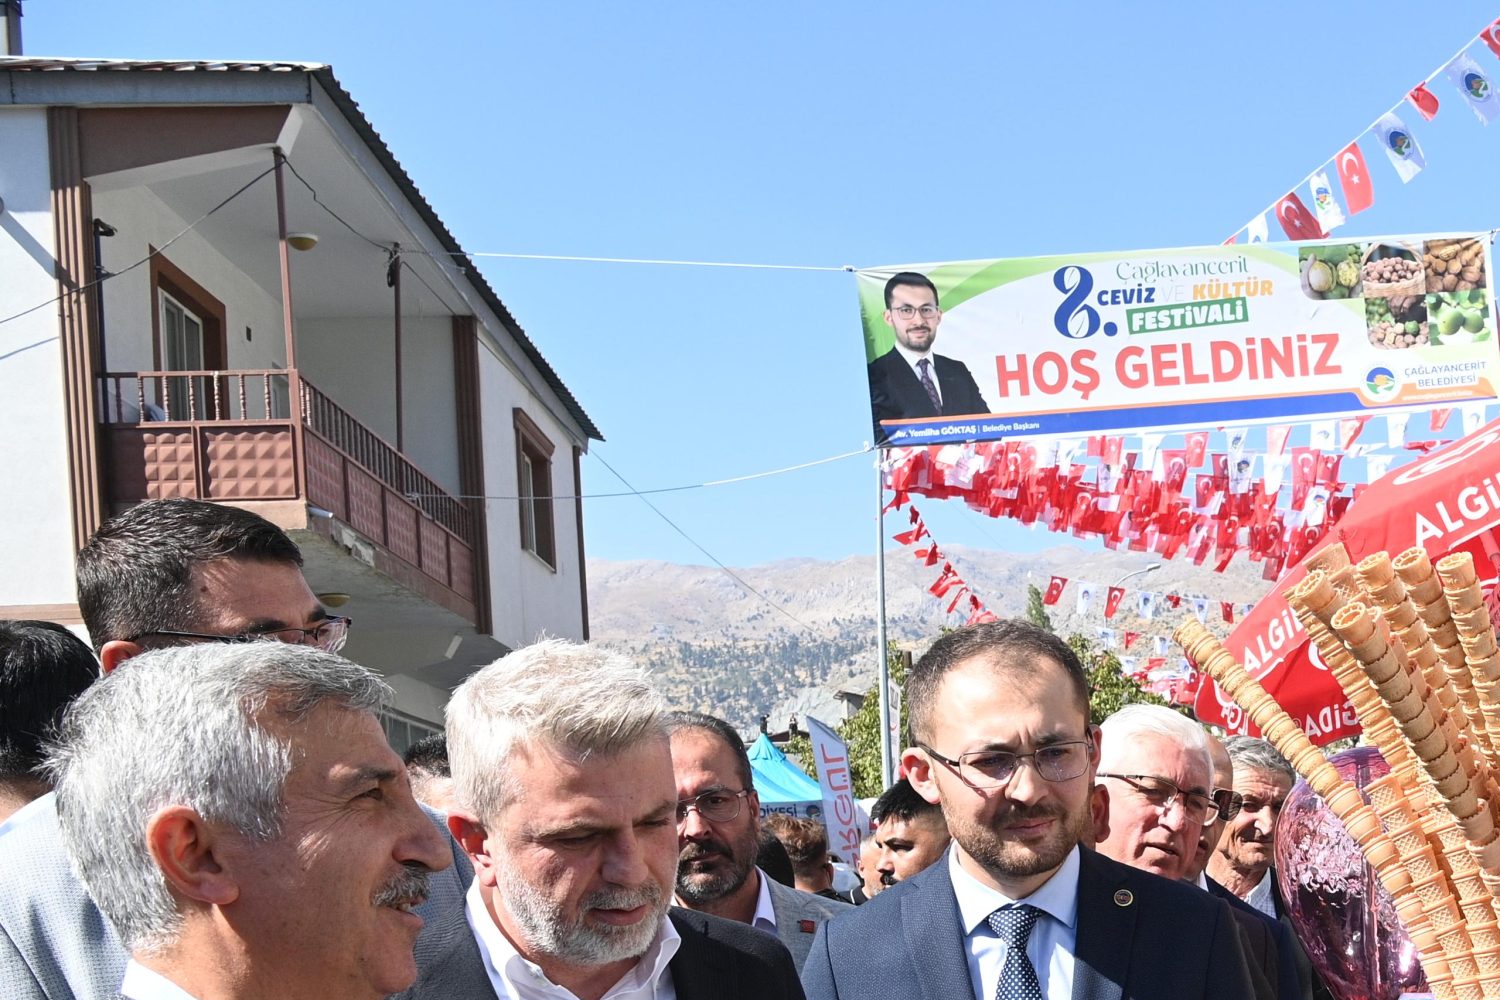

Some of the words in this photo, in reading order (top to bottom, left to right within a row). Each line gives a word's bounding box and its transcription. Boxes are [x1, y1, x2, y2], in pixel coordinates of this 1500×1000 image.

[1116, 255, 1249, 285] Çağlayancerit
[1053, 265, 1118, 339] 8.
[1097, 283, 1156, 306] CEVİZ
[1163, 283, 1186, 302] VE
[1192, 277, 1274, 300] KÜLTÜR
[995, 349, 1100, 400] HOŞ
[1404, 361, 1487, 377] ÇAĞLAYANCERİT
[1418, 374, 1476, 388] BELEDİYESİ
[940, 425, 977, 436] GÖKTAŞ
[982, 424, 1012, 433] Belediye
[1013, 422, 1040, 431] Başkanı
